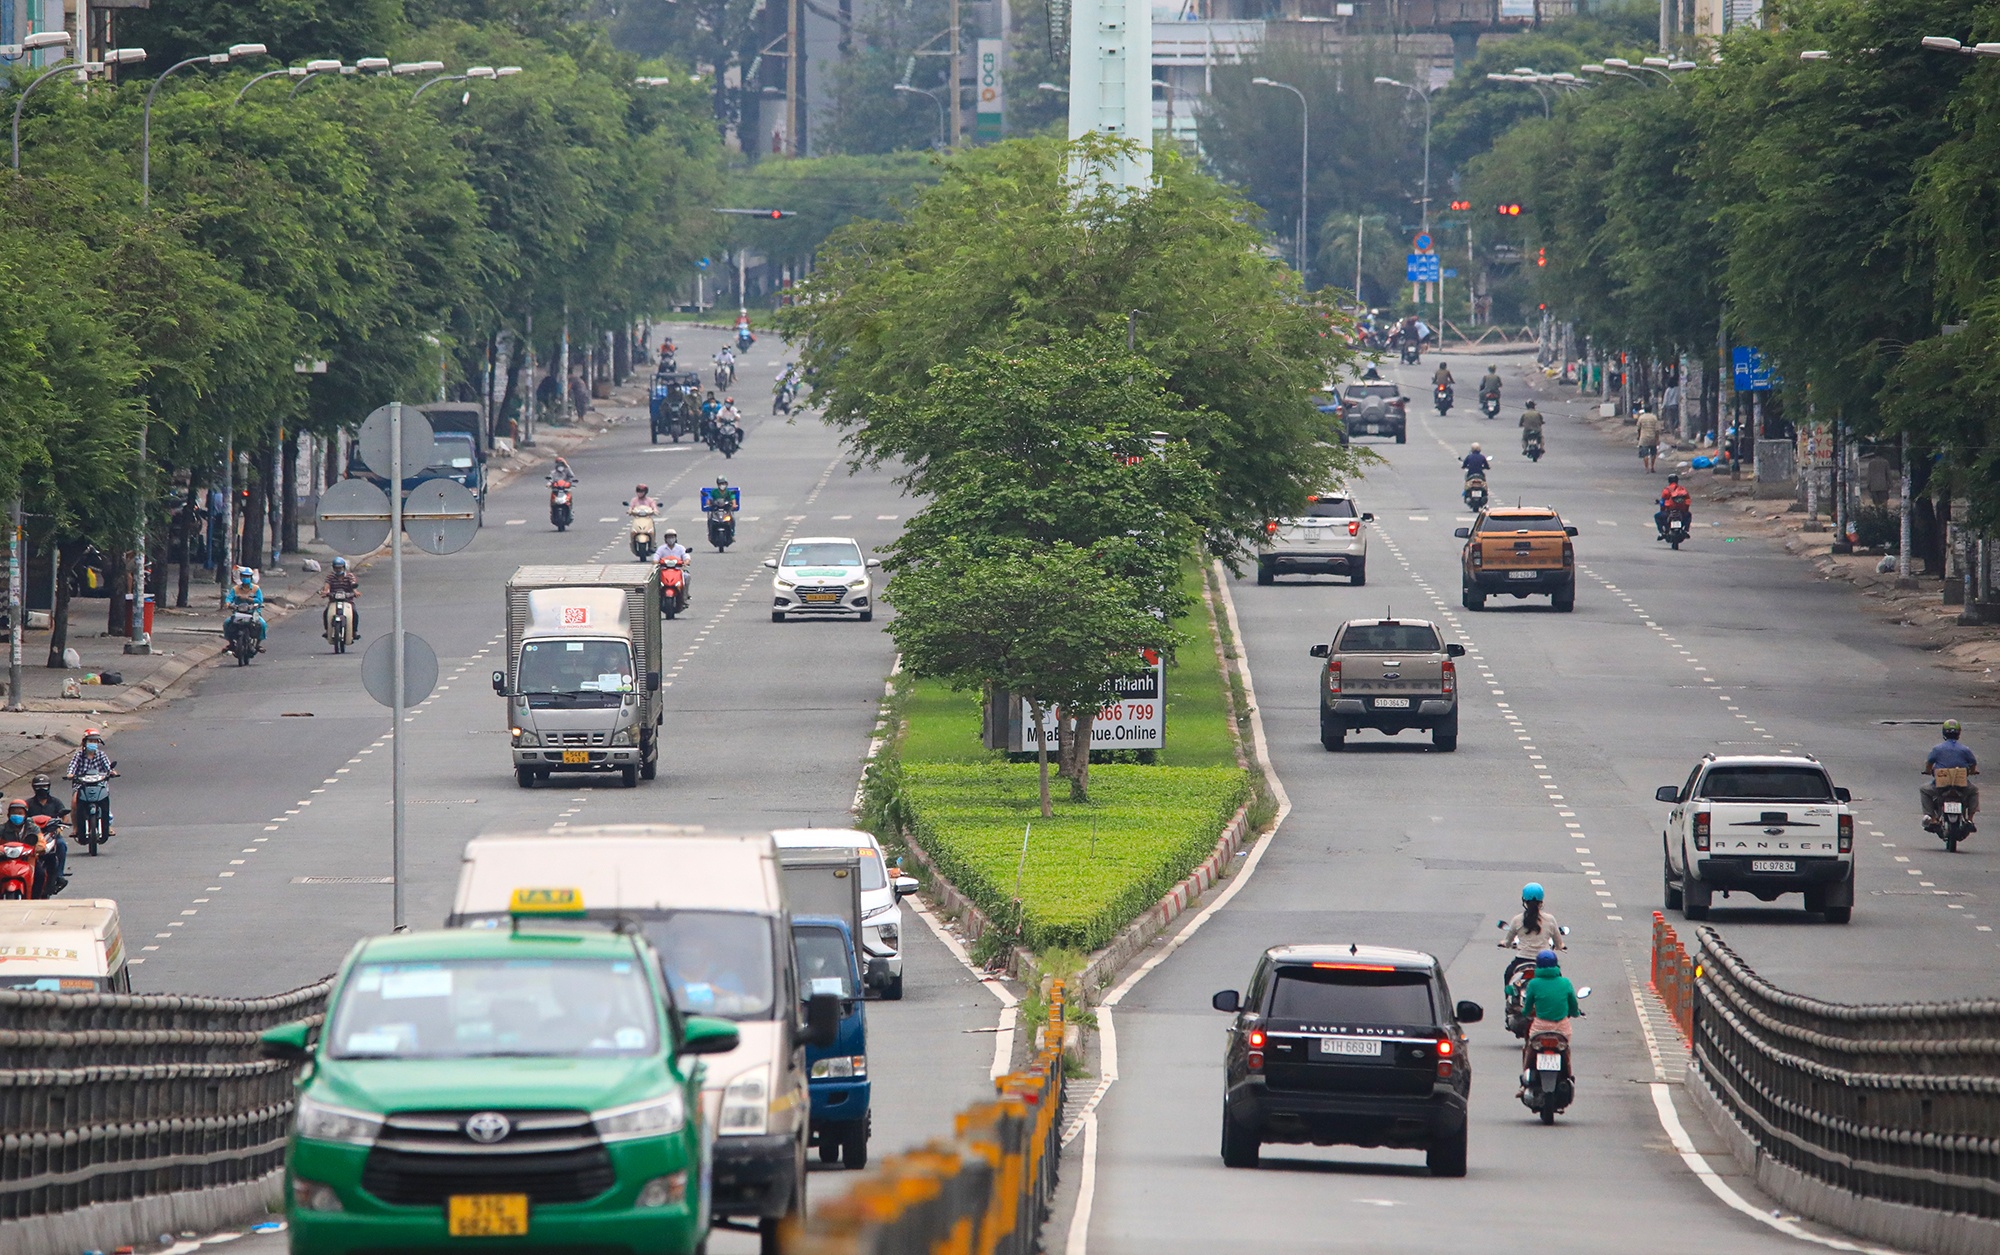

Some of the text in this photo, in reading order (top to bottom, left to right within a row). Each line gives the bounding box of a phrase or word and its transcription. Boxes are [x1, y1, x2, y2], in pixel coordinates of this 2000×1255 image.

[983, 53, 994, 87] OCB
[1114, 674, 1154, 691] nhanh
[1343, 682, 1440, 690] RANGER
[1127, 703, 1154, 720] 799
[1715, 841, 1832, 850] RANGER
[1300, 1025, 1405, 1036] RANGE ROVER
